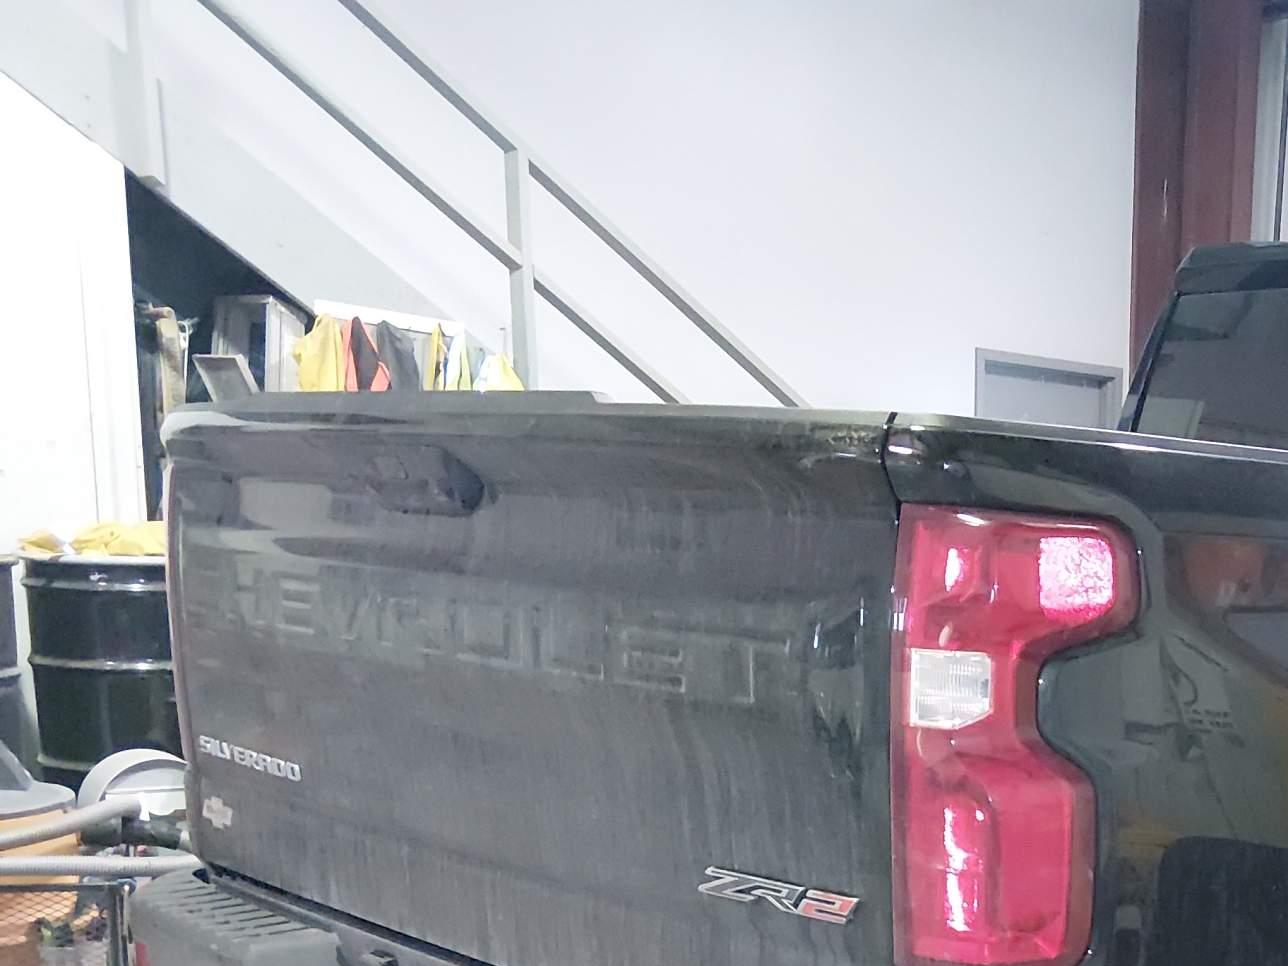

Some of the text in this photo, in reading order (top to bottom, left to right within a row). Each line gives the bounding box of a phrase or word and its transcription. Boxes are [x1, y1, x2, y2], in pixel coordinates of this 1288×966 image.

[188, 560, 792, 704] HEVROLET
[199, 734, 302, 782] SILVERADO
[697, 865, 860, 925] ZR2
